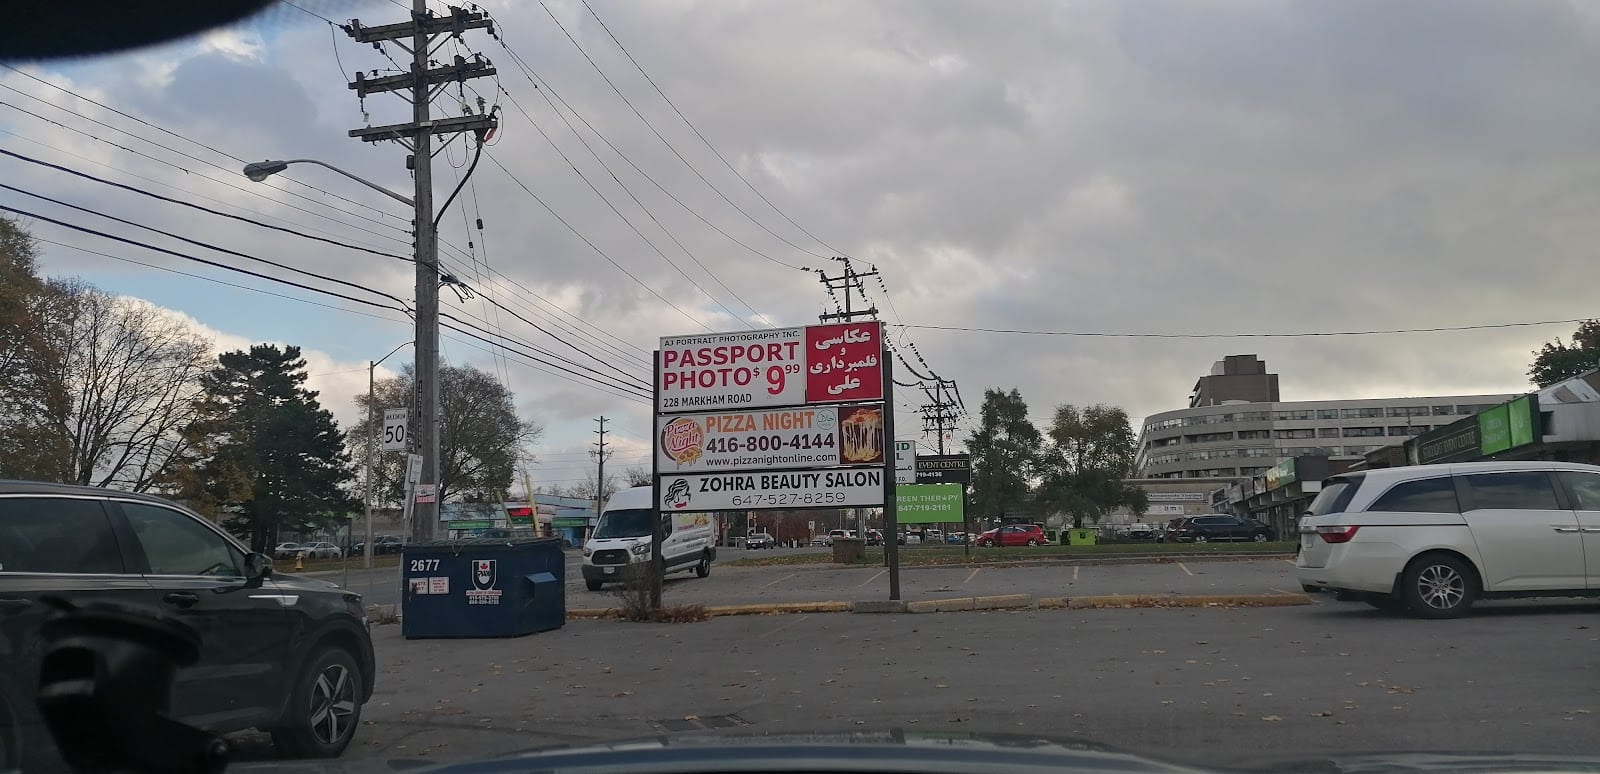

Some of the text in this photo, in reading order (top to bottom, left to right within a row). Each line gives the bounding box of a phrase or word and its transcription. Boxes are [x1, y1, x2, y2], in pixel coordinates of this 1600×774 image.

[664, 330, 800, 347] AJ PORTRAIT PHOTOGRAPHY INC.
[664, 341, 799, 369] PASSPORT
[840, 347, 846, 356] و
[663, 367, 752, 391] PHOTO
[827, 375, 861, 395] علی
[664, 394, 752, 408] 228 MARKHAM ROAD
[664, 421, 696, 436] Pizza
[706, 412, 815, 433] PIZZA NIGHT
[385, 425, 404, 443] 50
[668, 432, 701, 450] Night
[706, 432, 835, 453] 416-800-4144
[706, 453, 837, 467] www.pizzanightonline.com
[699, 471, 881, 492] ZOHRA BEAUTY SALON
[732, 492, 846, 506] 647-527-8259
[411, 559, 440, 571] 2677
